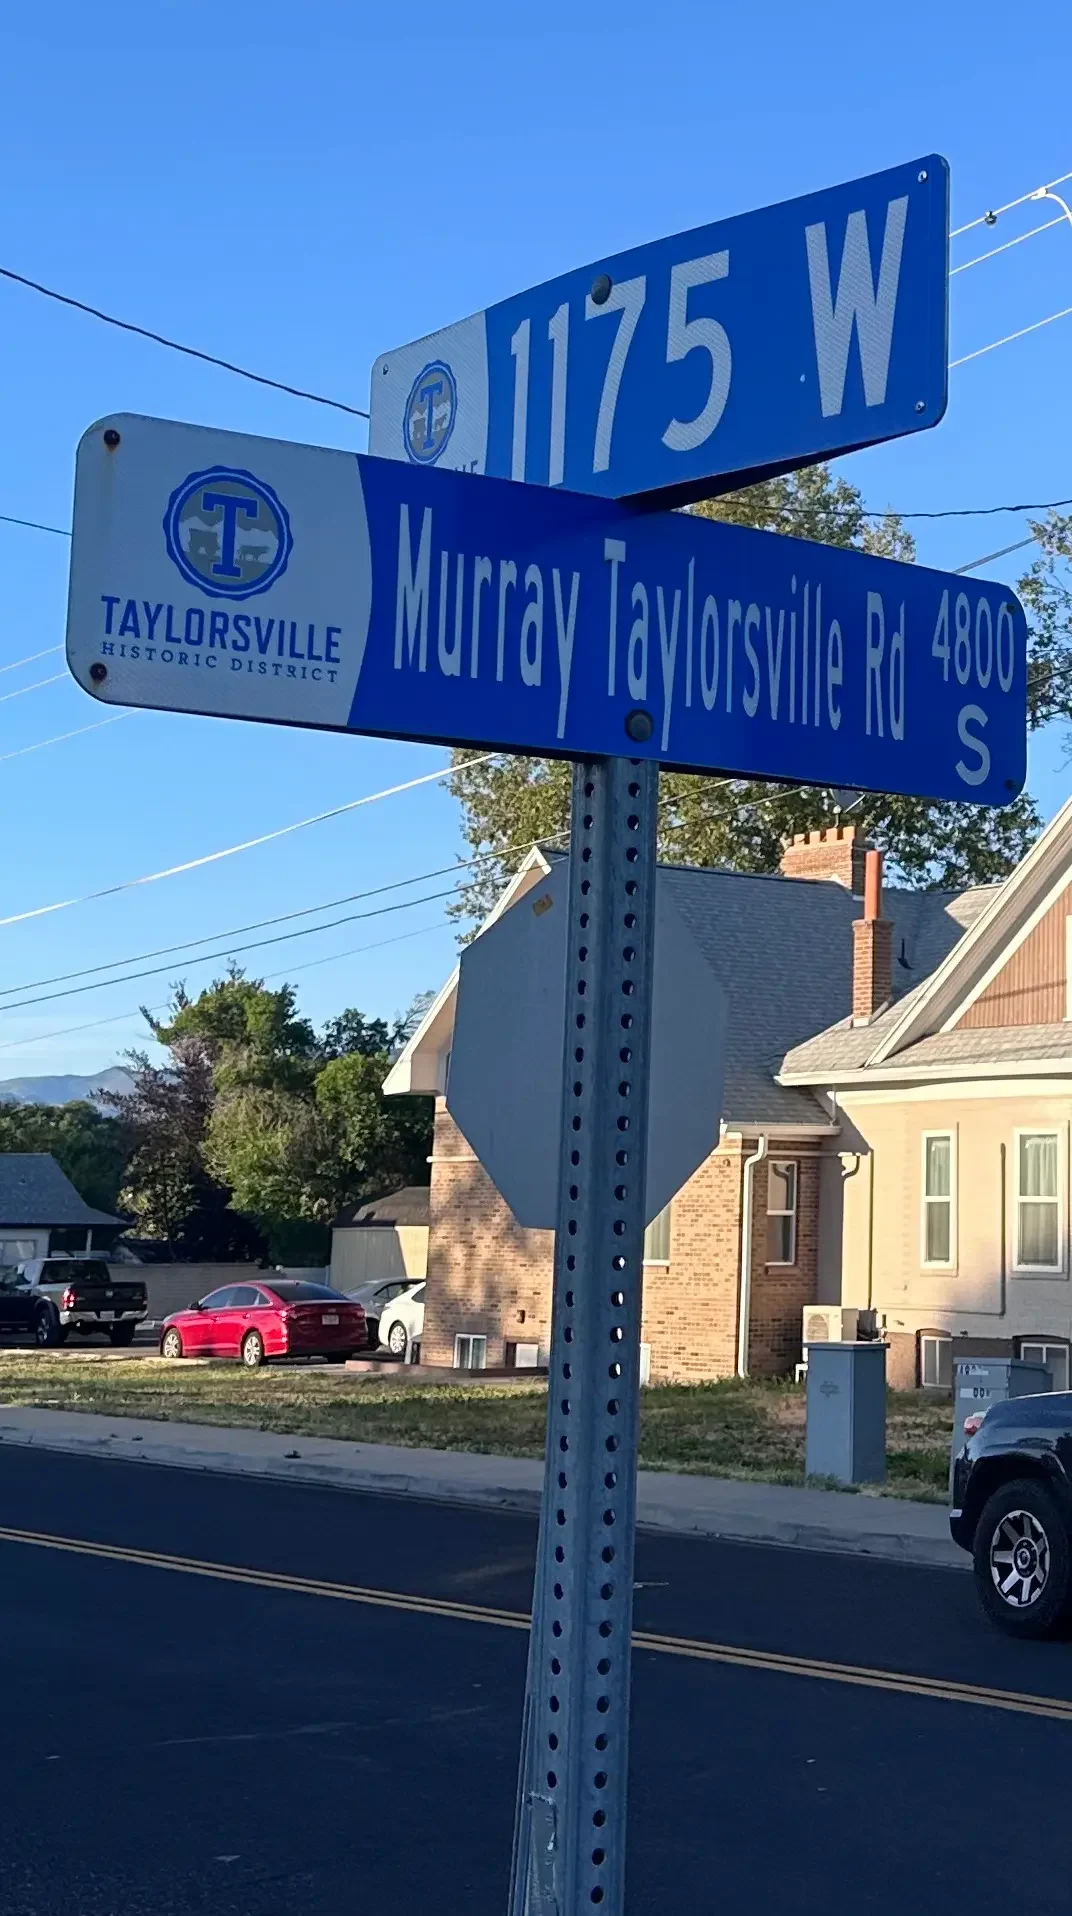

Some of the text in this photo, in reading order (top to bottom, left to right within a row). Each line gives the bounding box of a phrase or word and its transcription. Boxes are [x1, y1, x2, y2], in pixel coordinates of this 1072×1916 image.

[511, 195, 908, 486] 1175 W
[420, 382, 443, 450] T
[202, 492, 258, 577] T
[100, 641, 340, 684] HISTORIC DISTRICT
[101, 595, 342, 664] TAYLORSVILLE
[394, 503, 906, 751] Murray Taylorsville Rd
[931, 588, 1015, 693] 4800
[955, 703, 992, 786] S
